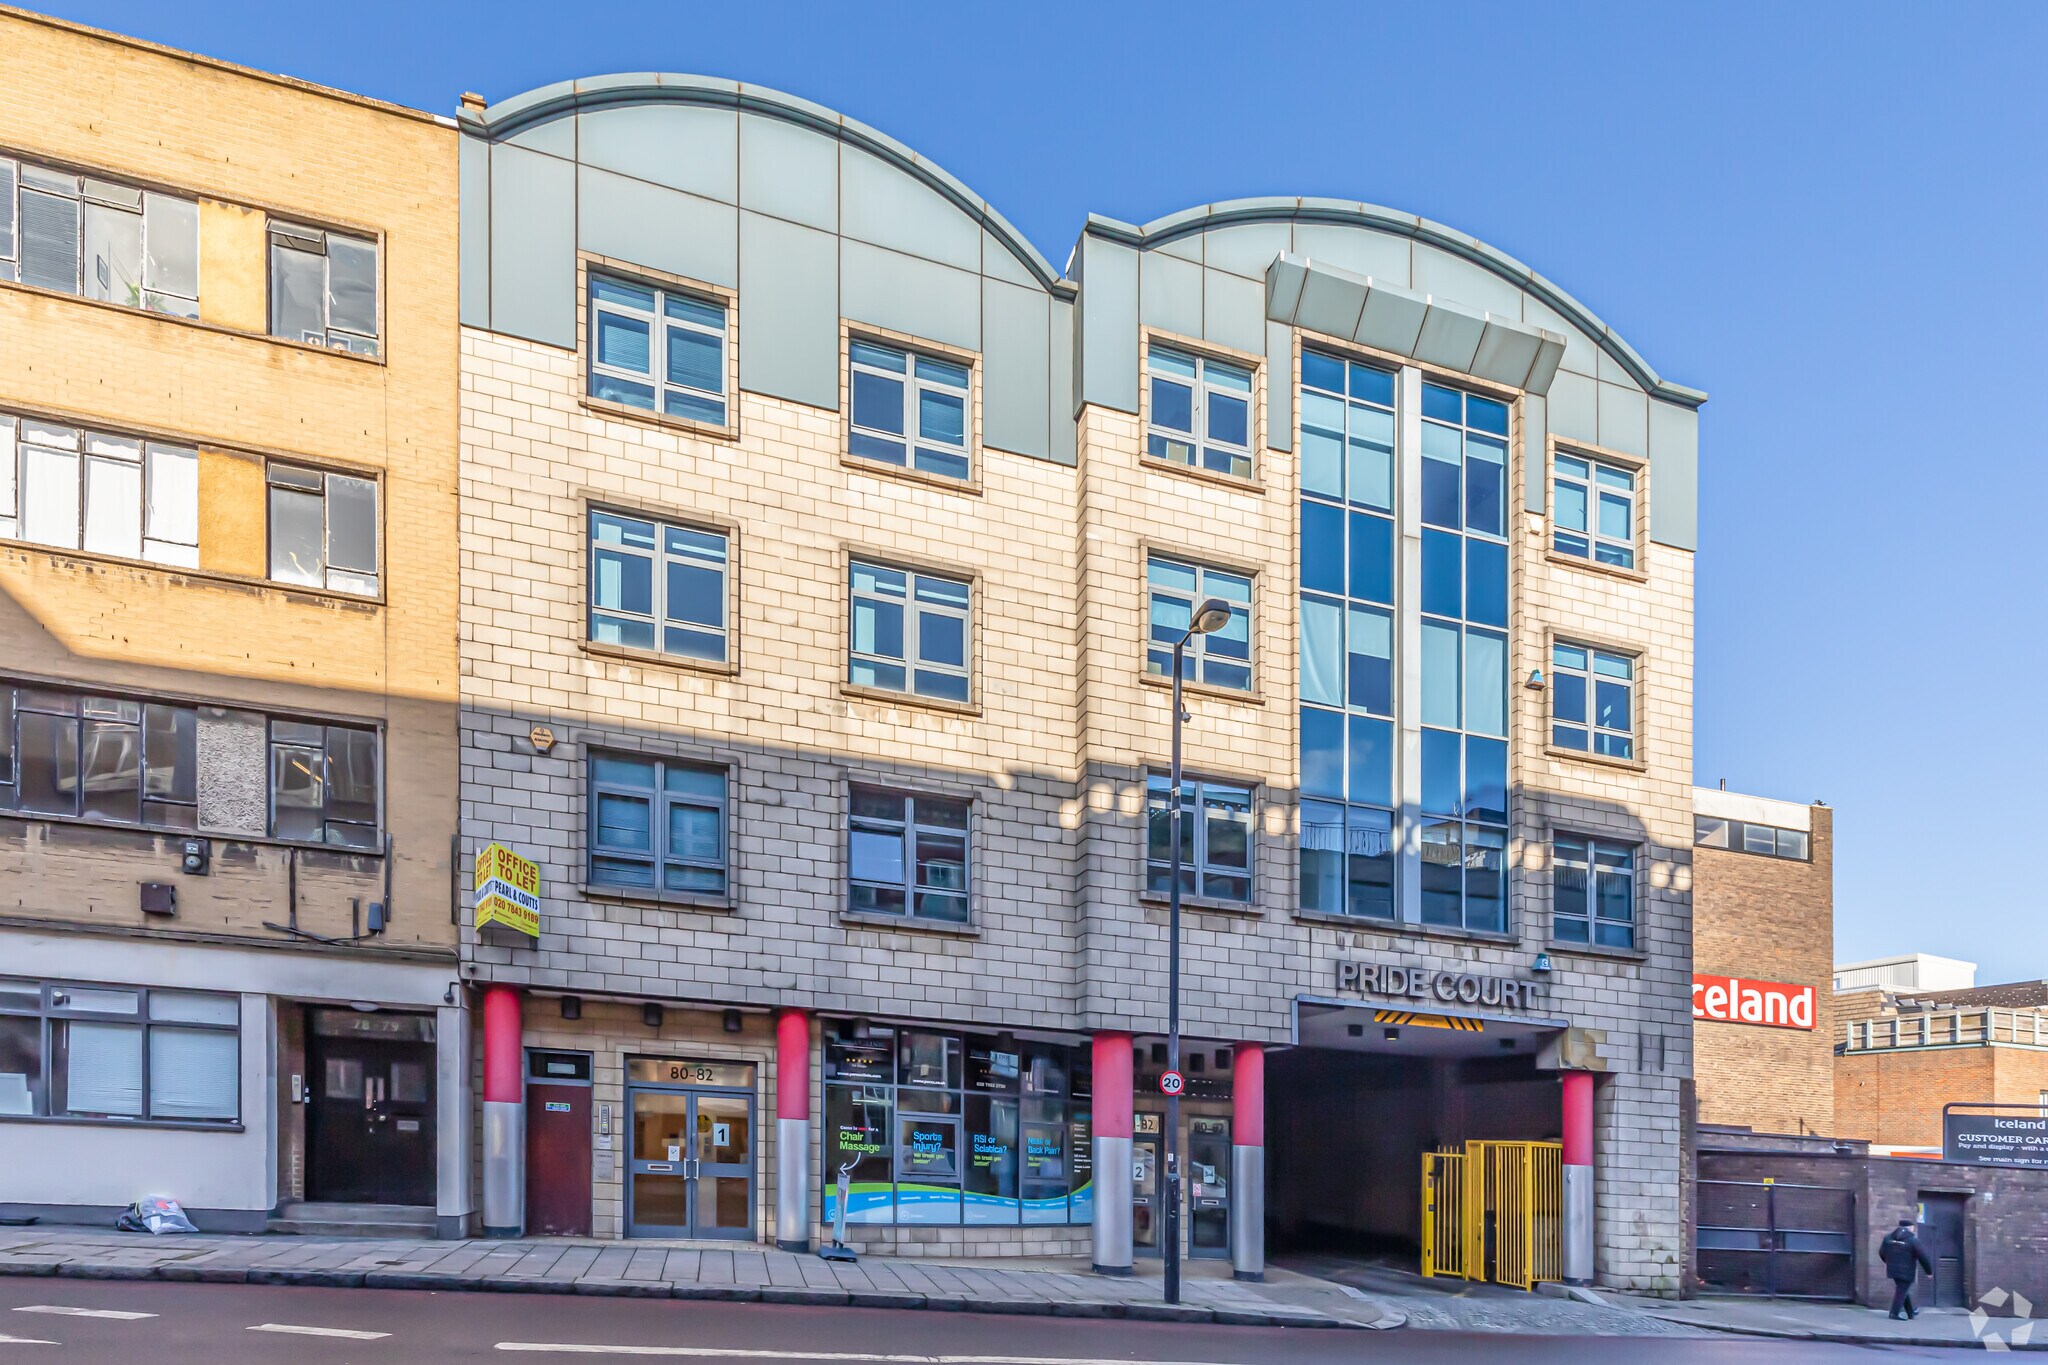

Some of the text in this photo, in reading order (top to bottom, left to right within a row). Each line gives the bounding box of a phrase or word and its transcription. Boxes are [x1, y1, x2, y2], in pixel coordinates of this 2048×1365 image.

[498, 849, 536, 879] OFFICE
[498, 863, 536, 892] TO LET
[495, 880, 512, 899] PEARL
[513, 889, 518, 901] &
[518, 892, 539, 910] COUTTS
[494, 897, 506, 910] 020
[507, 902, 522, 917] 7843
[1336, 960, 1538, 1008] PRIDE COURT
[1692, 978, 1813, 1027] celand
[670, 1066, 714, 1081] 80-82
[1163, 1077, 1181, 1089] 20
[1133, 1119, 1154, 1131] -82
[1995, 1118, 2046, 1130] Iceland
[718, 1128, 725, 1142] 1
[839, 1130, 864, 1142] Chair
[913, 1131, 943, 1142] Sports
[973, 1134, 987, 1144] RSI
[1958, 1133, 2023, 1144] CUSTOMER
[839, 1140, 881, 1154] Massage
[913, 1141, 941, 1153] Injury?
[973, 1143, 1008, 1154] Sciatica?
[1027, 1145, 1061, 1156] Back Pain?
[1958, 1142, 1971, 1150] Pay
[1988, 1143, 2014, 1152] display
[2013, 1157, 2030, 1165] sign
[1135, 1166, 1143, 1178] 2
